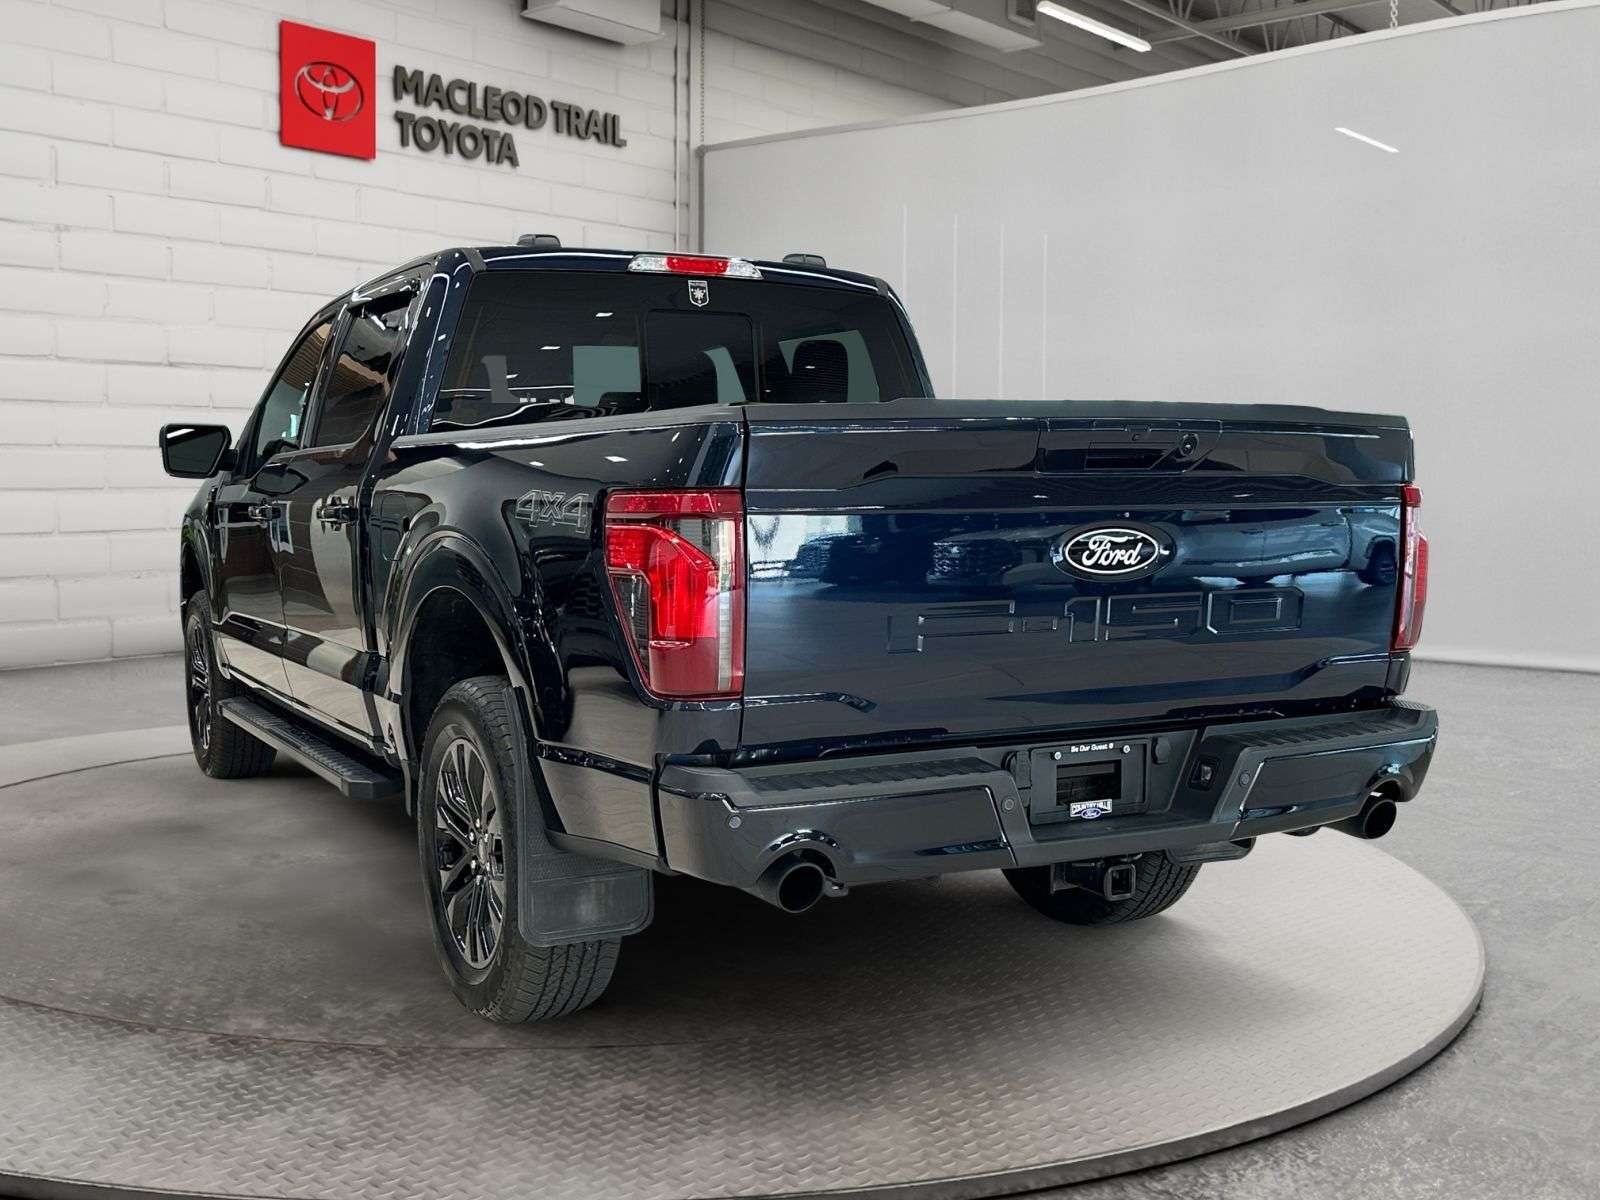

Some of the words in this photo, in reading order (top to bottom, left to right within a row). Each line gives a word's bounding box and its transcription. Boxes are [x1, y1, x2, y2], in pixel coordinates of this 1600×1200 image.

[393, 64, 547, 130] MACLEOD
[551, 100, 627, 147] TRAIL
[394, 110, 520, 168] TOYOTA
[1081, 534, 1144, 568] Ford
[886, 585, 1304, 654] F-150
[1079, 744, 1091, 752] Our
